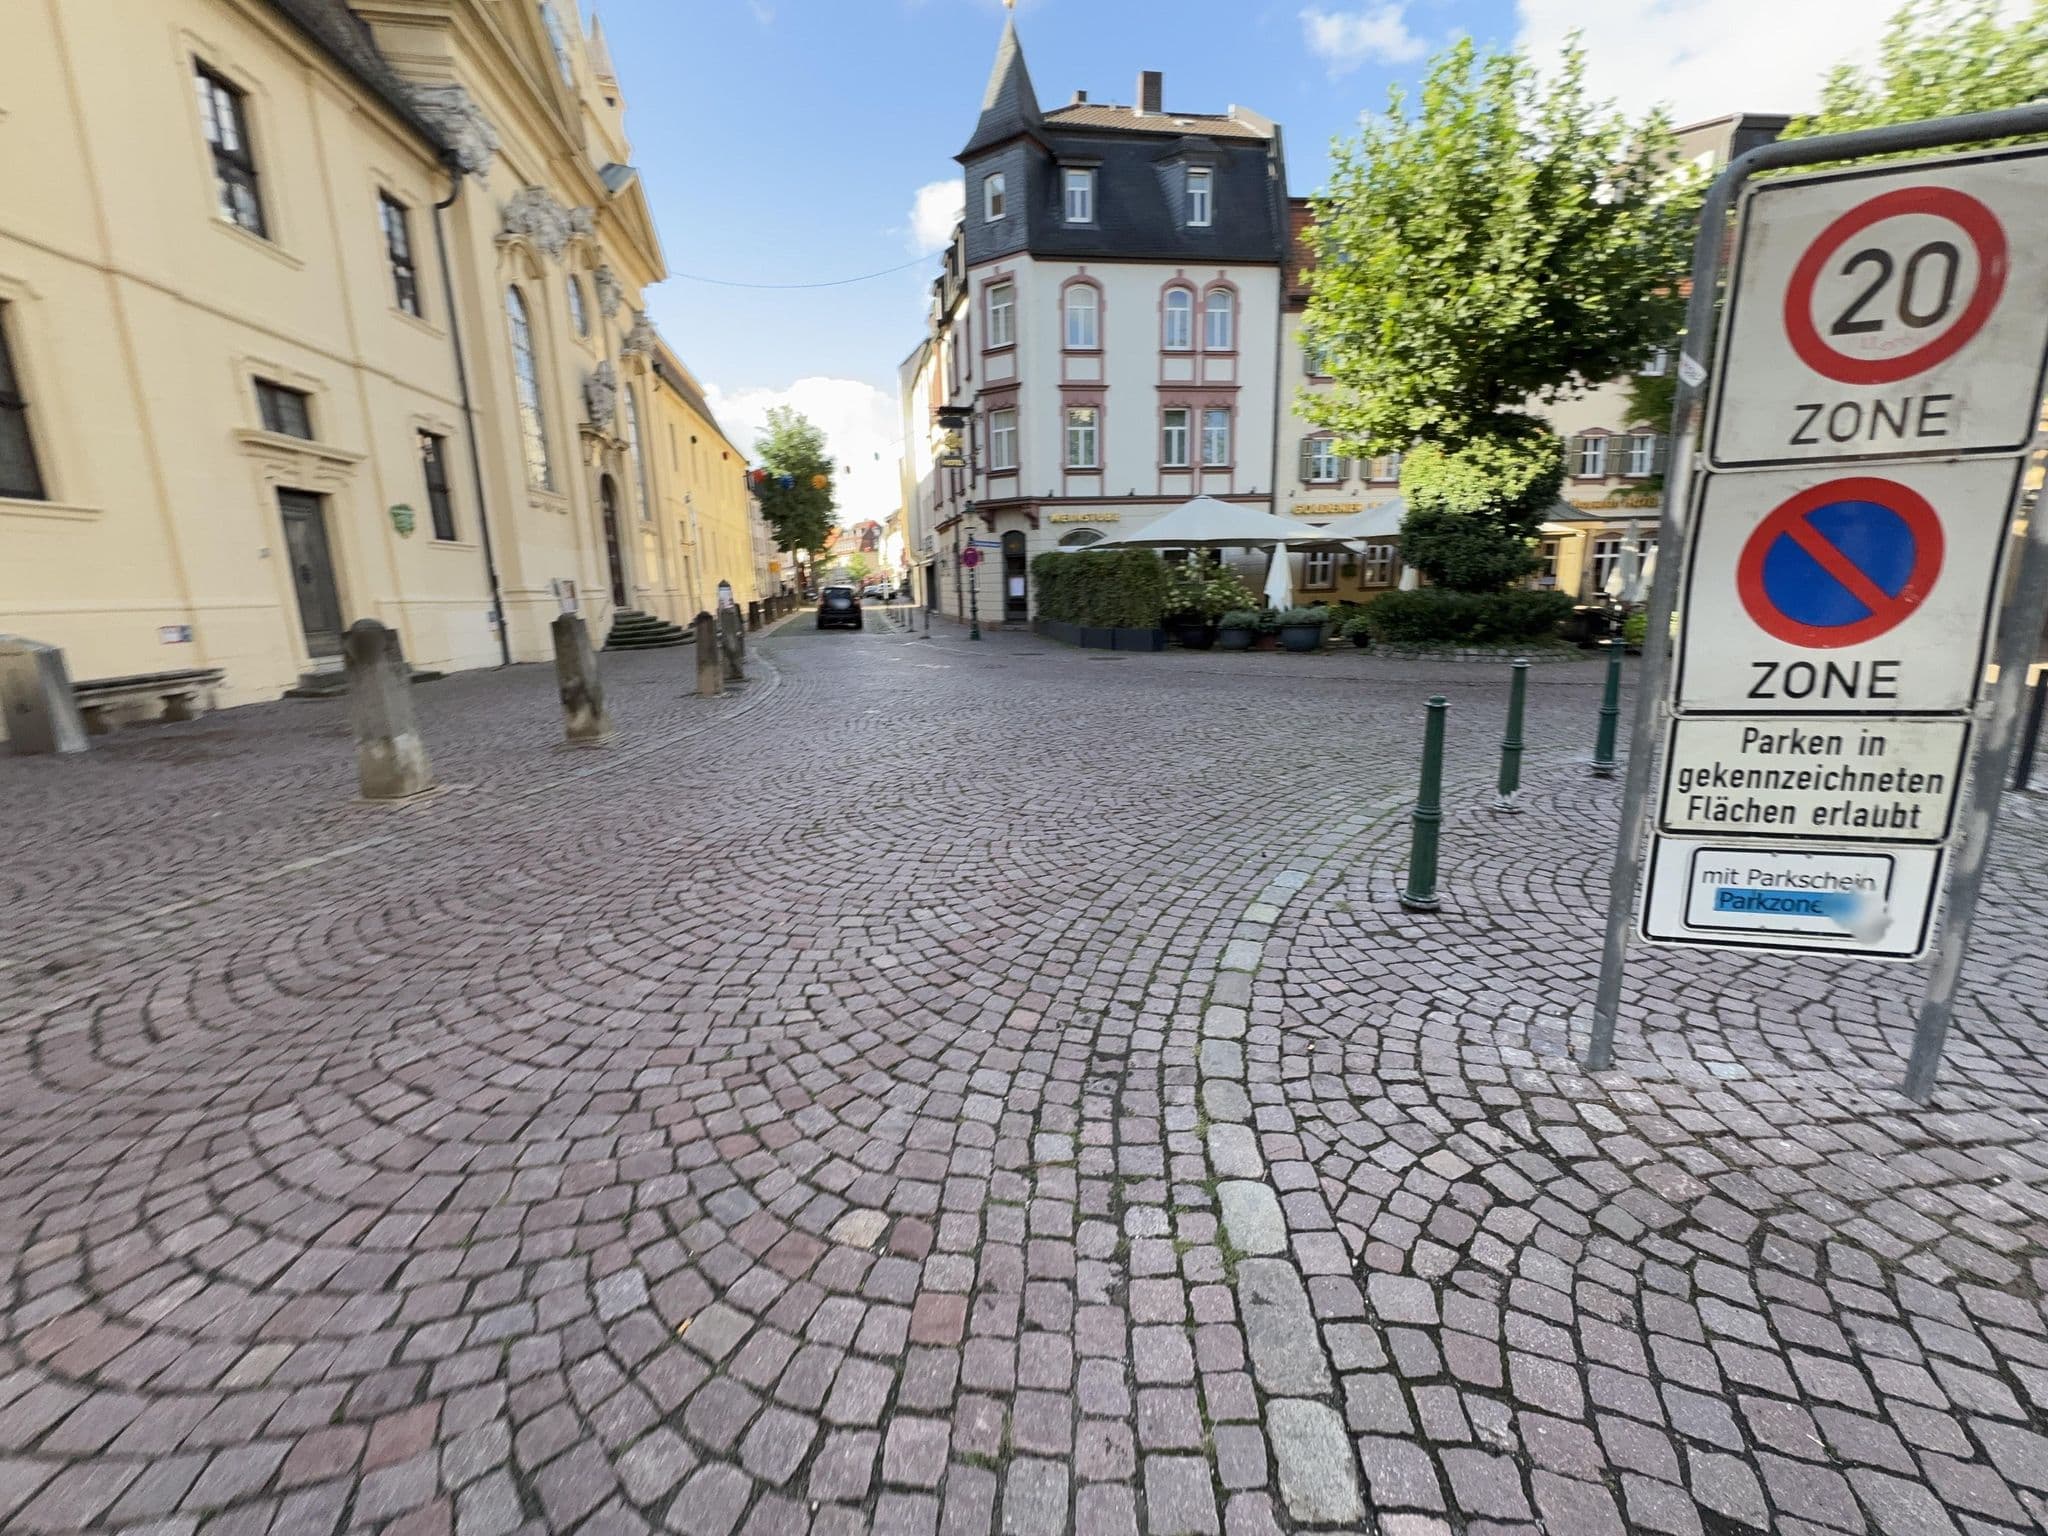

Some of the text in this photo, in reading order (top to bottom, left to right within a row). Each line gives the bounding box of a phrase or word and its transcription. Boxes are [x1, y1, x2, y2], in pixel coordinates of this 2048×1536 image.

[1830, 241, 1960, 336] 20
[1788, 393, 1954, 446] ZONE
[1746, 660, 1902, 700] ZONE
[1741, 727, 1887, 756] Parken in
[1677, 762, 1945, 794] gekennzeichneten
[1687, 795, 1922, 830] Flächen erlaubt
[1702, 868, 1878, 891] mit Parkschein
